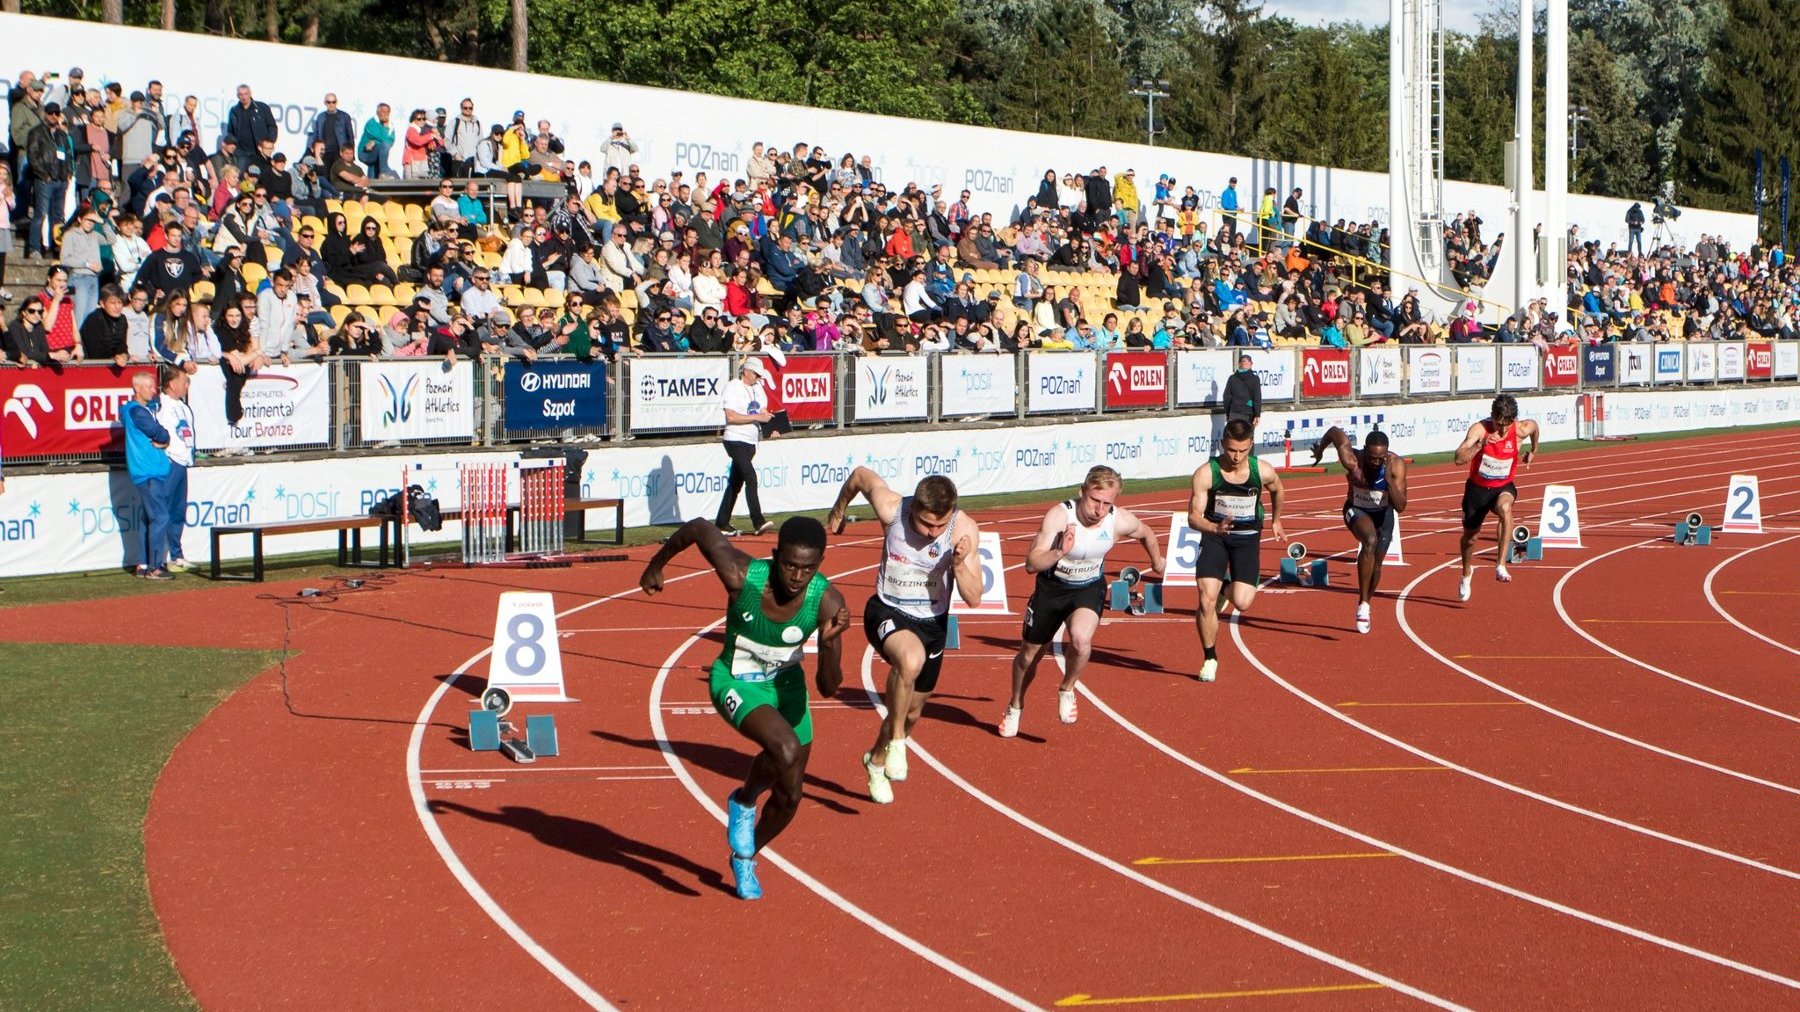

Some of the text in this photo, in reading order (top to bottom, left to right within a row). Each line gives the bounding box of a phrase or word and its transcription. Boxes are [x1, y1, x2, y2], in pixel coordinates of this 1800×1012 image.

[1323, 364, 1347, 381] ORLEN
[1559, 359, 1576, 372] ORLEN
[542, 373, 591, 389] HYUNDAI
[657, 377, 719, 397] TAMEX
[785, 377, 828, 398] ORLEN
[1041, 376, 1081, 395] POZnan
[1133, 369, 1163, 387] ORLEN
[242, 401, 295, 418] ontinental
[425, 397, 460, 414] Athletics
[542, 398, 576, 420] Szpot
[255, 421, 294, 438] Bronze
[1016, 448, 1056, 468] POZnan
[1106, 442, 1142, 461] POZnan
[287, 484, 341, 519] posir
[1731, 486, 1755, 520] 2
[184, 501, 250, 528] OZnan
[1547, 497, 1571, 534] 3
[1175, 526, 1202, 569] 5
[879, 621, 888, 635] 7
[505, 613, 546, 676] 8
[725, 695, 737, 713] 8
